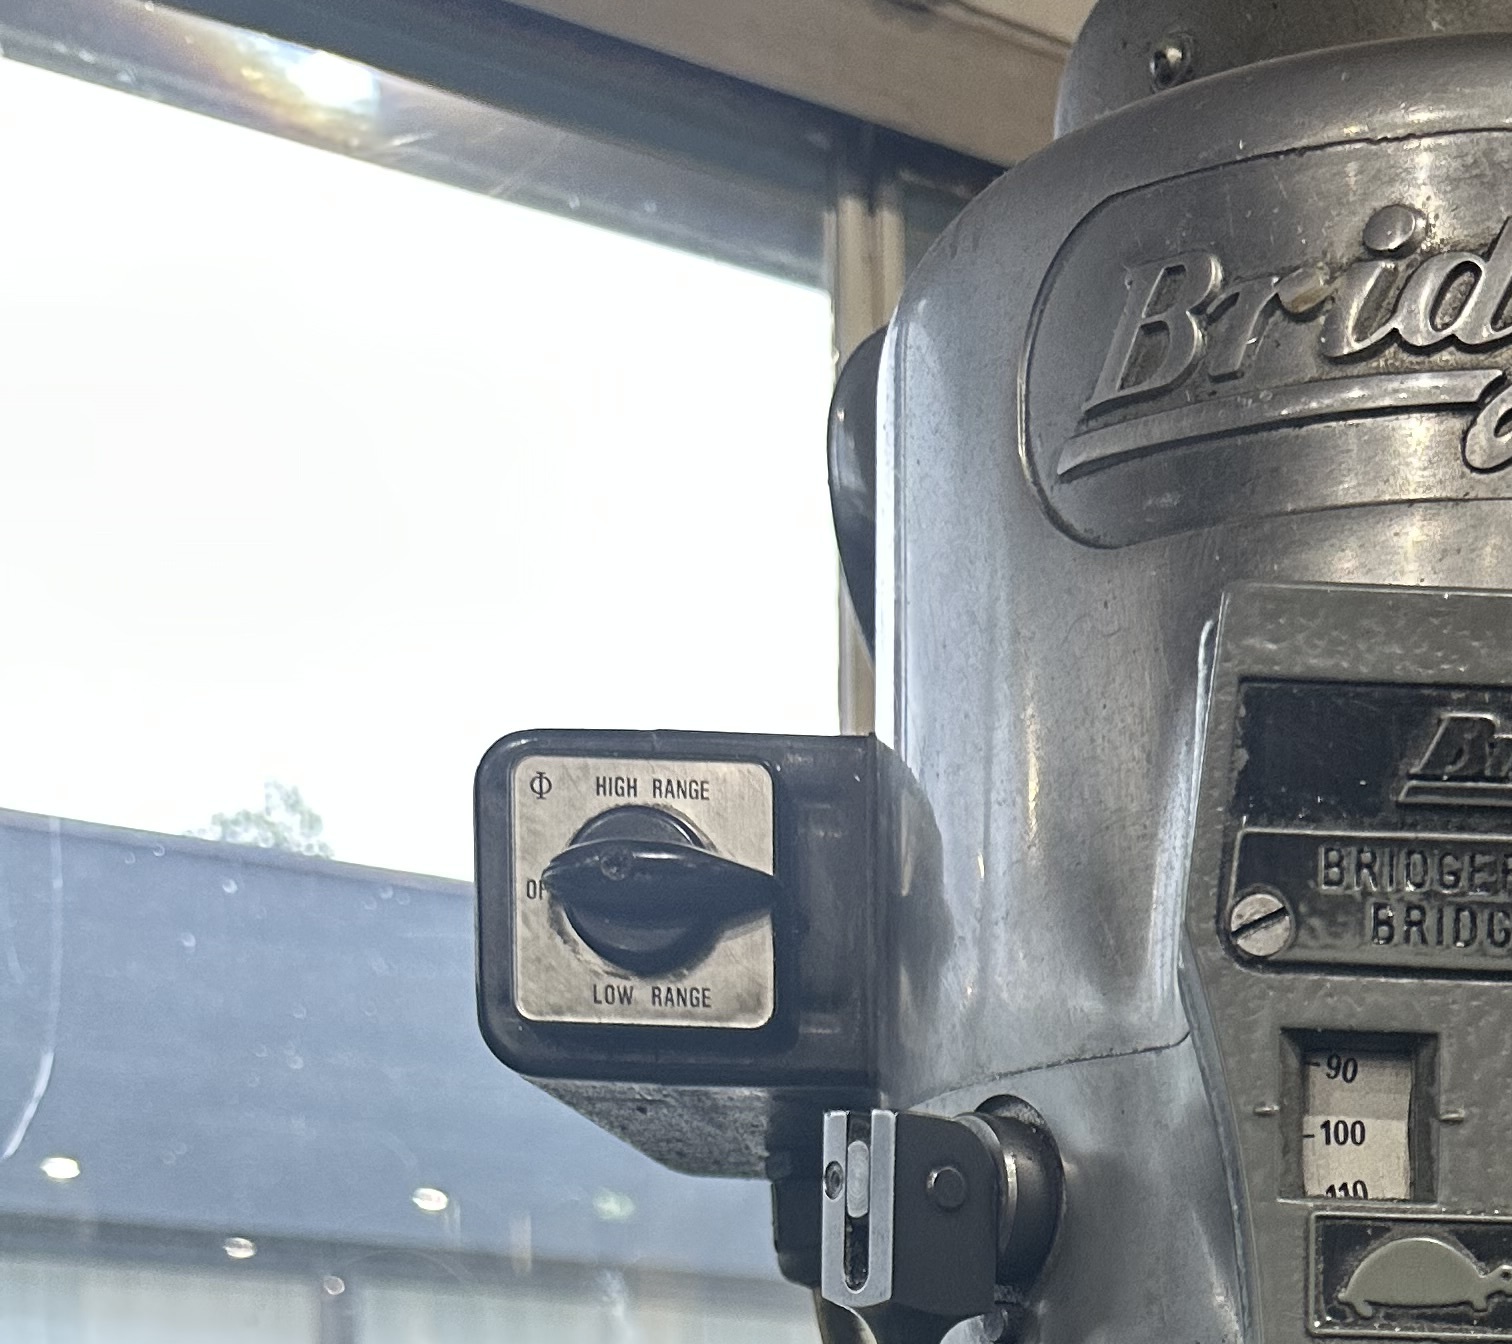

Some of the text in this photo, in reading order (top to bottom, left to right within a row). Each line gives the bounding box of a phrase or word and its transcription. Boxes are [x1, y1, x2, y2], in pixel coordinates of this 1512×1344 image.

[596, 776, 710, 801] HIGH RANGE
[592, 983, 712, 1008] LOW RANGE
[1325, 1054, 1359, 1084] 90
[1319, 1119, 1367, 1147] 100
